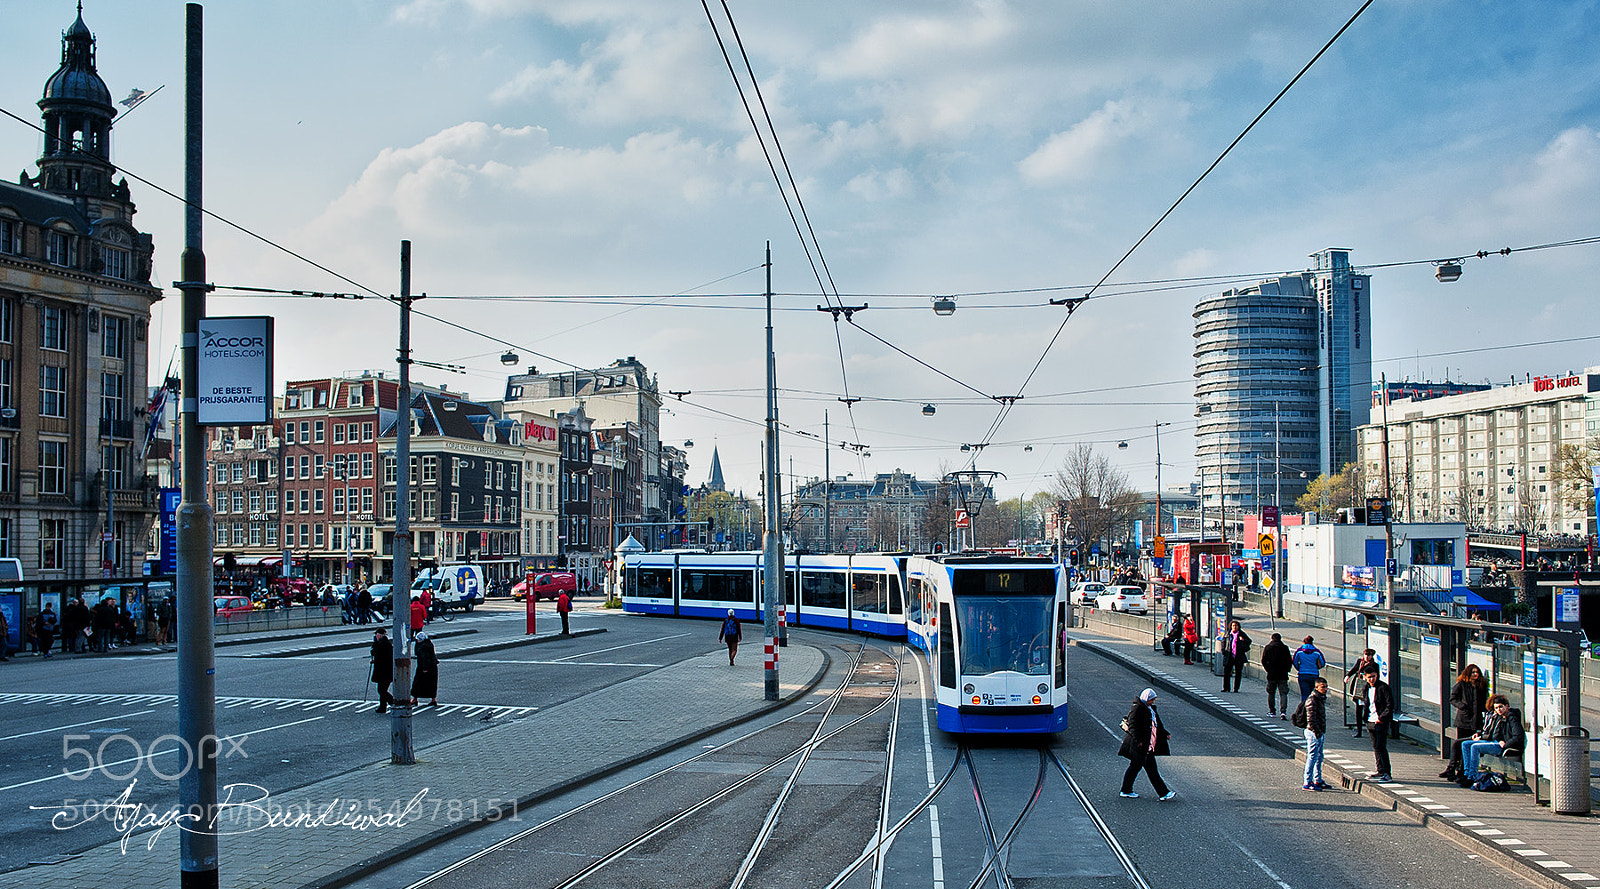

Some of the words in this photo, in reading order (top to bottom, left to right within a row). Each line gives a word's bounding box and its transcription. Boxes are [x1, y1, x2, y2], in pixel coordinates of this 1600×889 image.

[205, 337, 264, 348] ACCOR
[204, 349, 265, 358] HOTELS.COM
[1533, 375, 1554, 392] ibis
[1556, 376, 1582, 388] HOTEL
[212, 386, 223, 395] DE
[225, 386, 252, 395] BESTE
[249, 513, 269, 521] HOTEL
[1263, 543, 1271, 551] W
[1263, 556, 1269, 564] P
[1389, 560, 1395, 568] P
[997, 573, 1010, 588] 17
